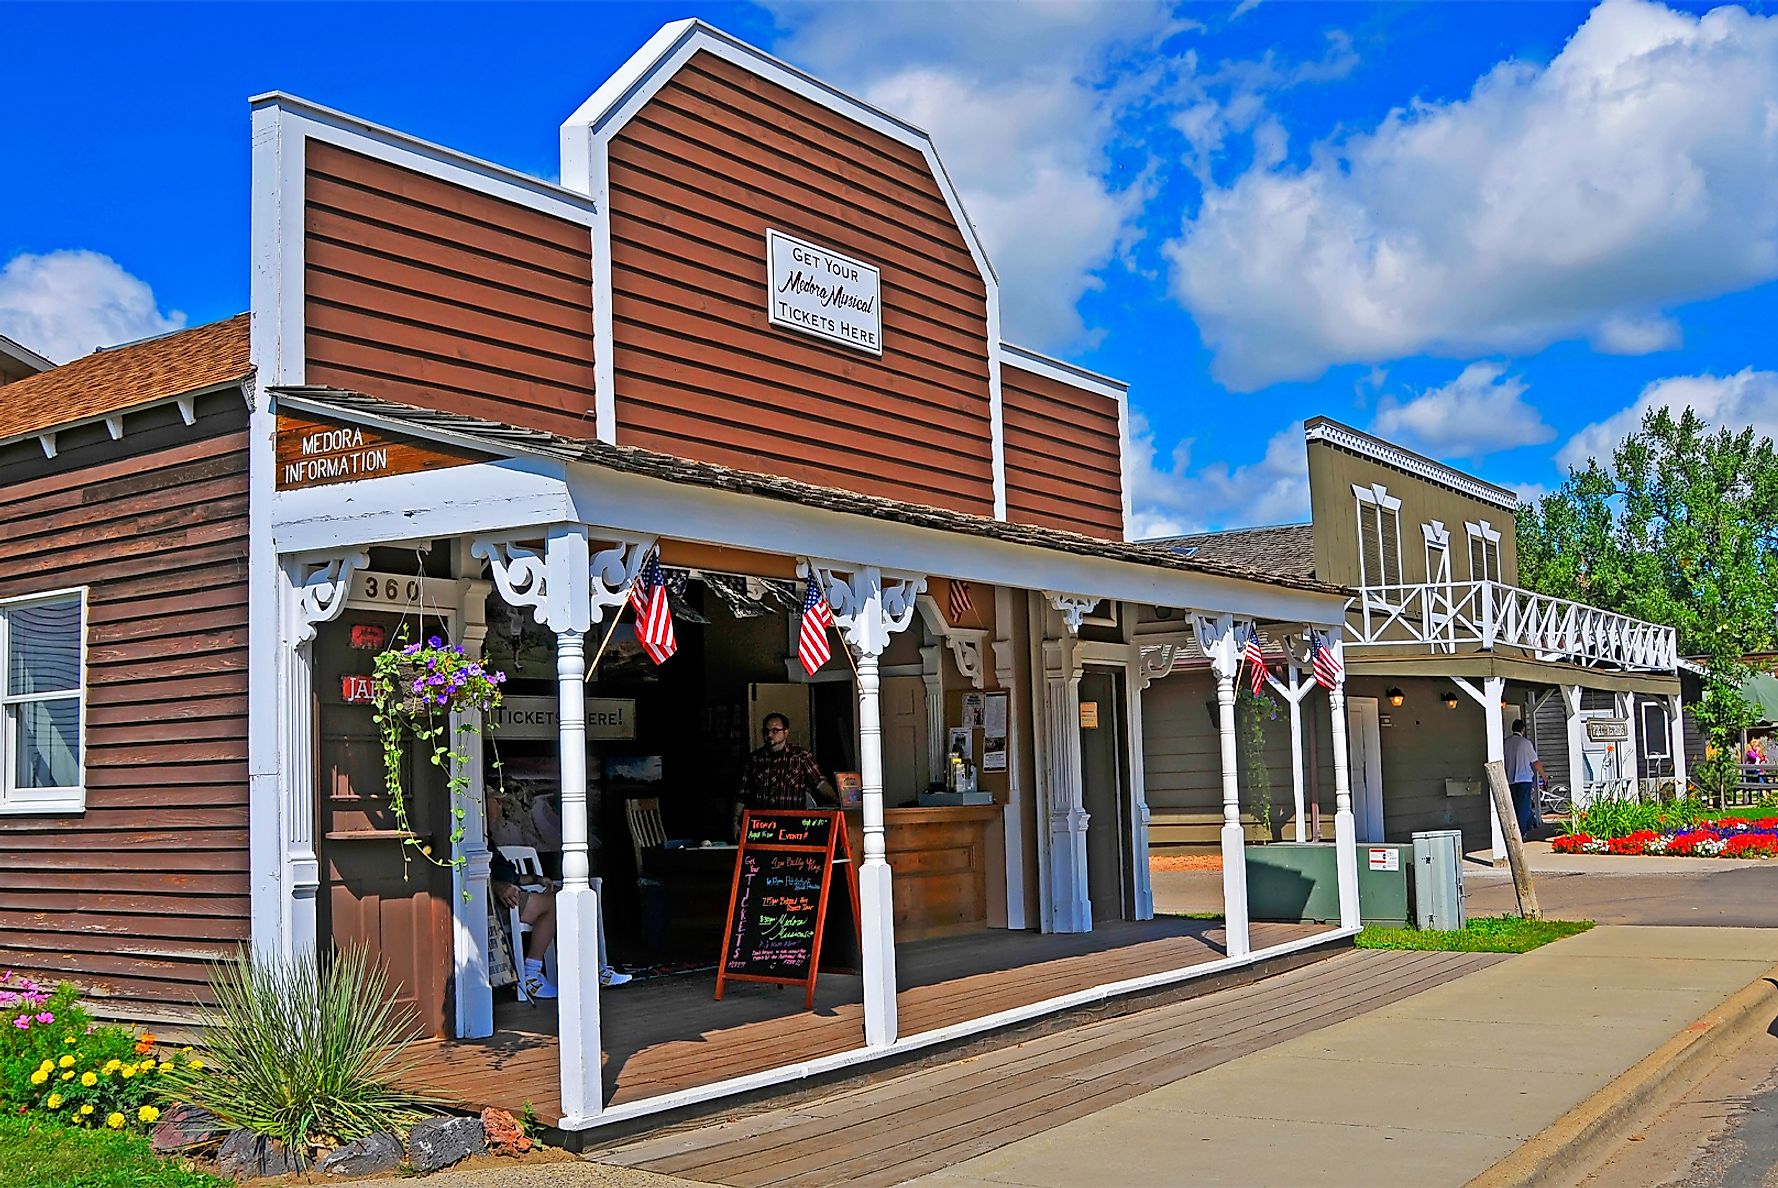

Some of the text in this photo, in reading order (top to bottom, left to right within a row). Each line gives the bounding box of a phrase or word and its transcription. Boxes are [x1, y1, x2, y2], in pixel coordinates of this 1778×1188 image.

[792, 247, 859, 282] GET YOUR
[778, 270, 874, 314] Medora Musical
[778, 301, 876, 345] TICKETS HERE
[302, 427, 363, 455] MEDORA
[285, 448, 387, 484] INFORMATION
[365, 576, 419, 602] 360
[347, 677, 379, 702] JAI
[588, 707, 623, 726] ERE!
